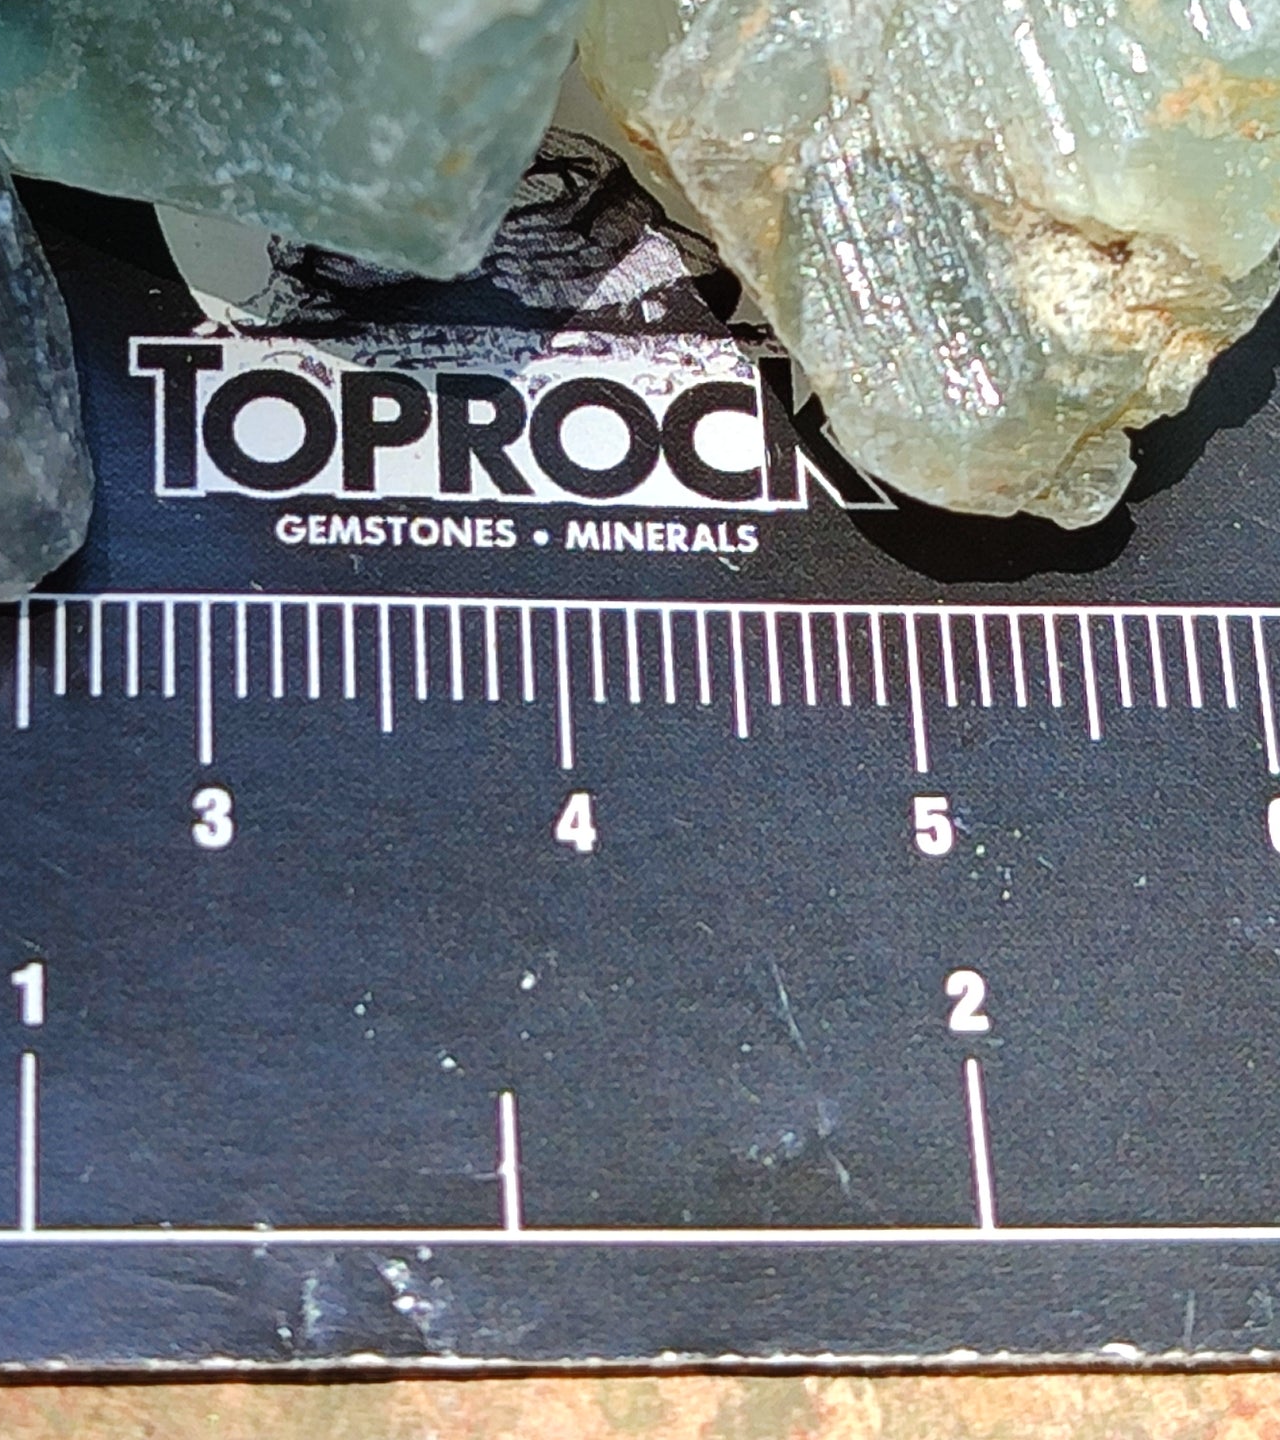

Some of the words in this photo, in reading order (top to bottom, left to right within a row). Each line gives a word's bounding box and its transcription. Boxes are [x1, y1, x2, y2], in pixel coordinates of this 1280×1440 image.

[274, 513, 518, 549] GEMSTONES
[564, 518, 760, 554] MINERALS
[191, 786, 235, 850] 3
[554, 791, 598, 853] 4
[912, 795, 954, 858] 5
[10, 961, 46, 1027] 1
[944, 969, 991, 1033] 2
